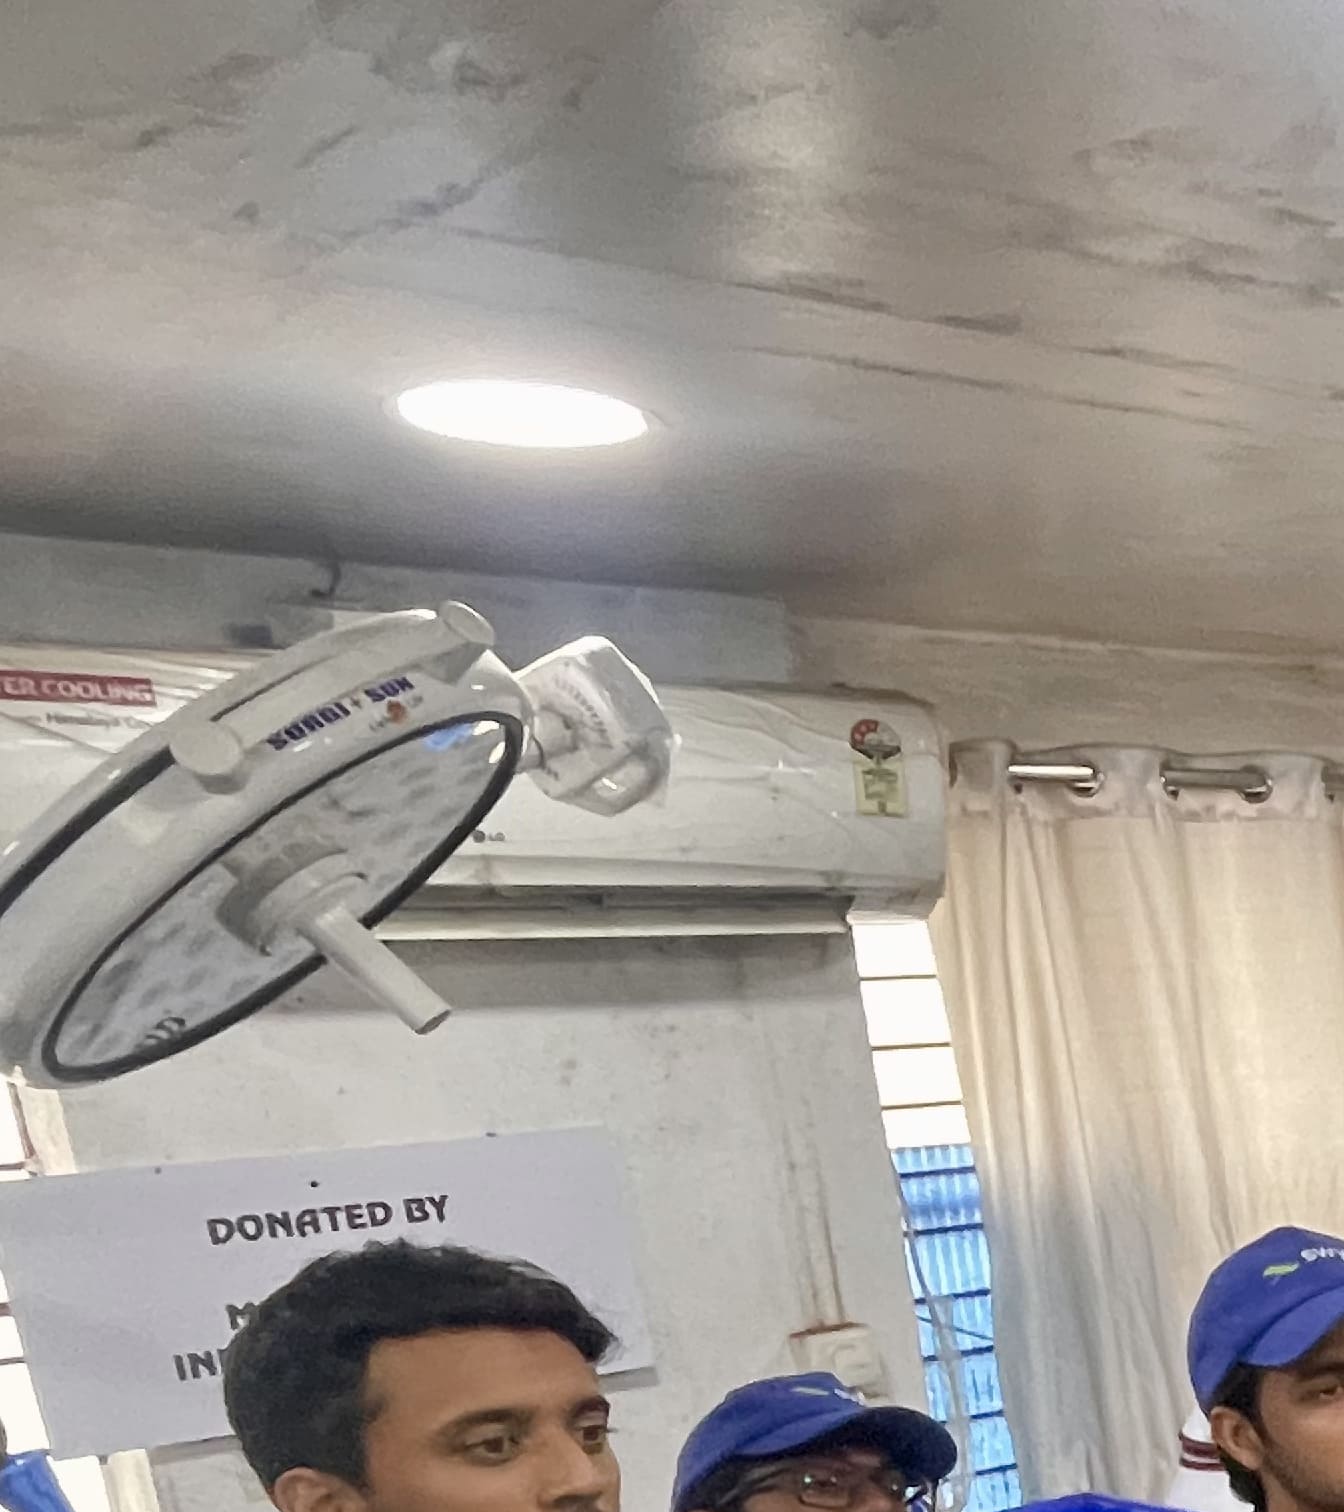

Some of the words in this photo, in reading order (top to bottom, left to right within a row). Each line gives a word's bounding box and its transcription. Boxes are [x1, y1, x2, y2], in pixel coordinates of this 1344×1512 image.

[0, 675, 38, 696] ER
[41, 680, 152, 702] COOLING
[207, 1201, 393, 1245] DONATED
[403, 1195, 449, 1223] BY
[173, 1350, 222, 1381] IN
